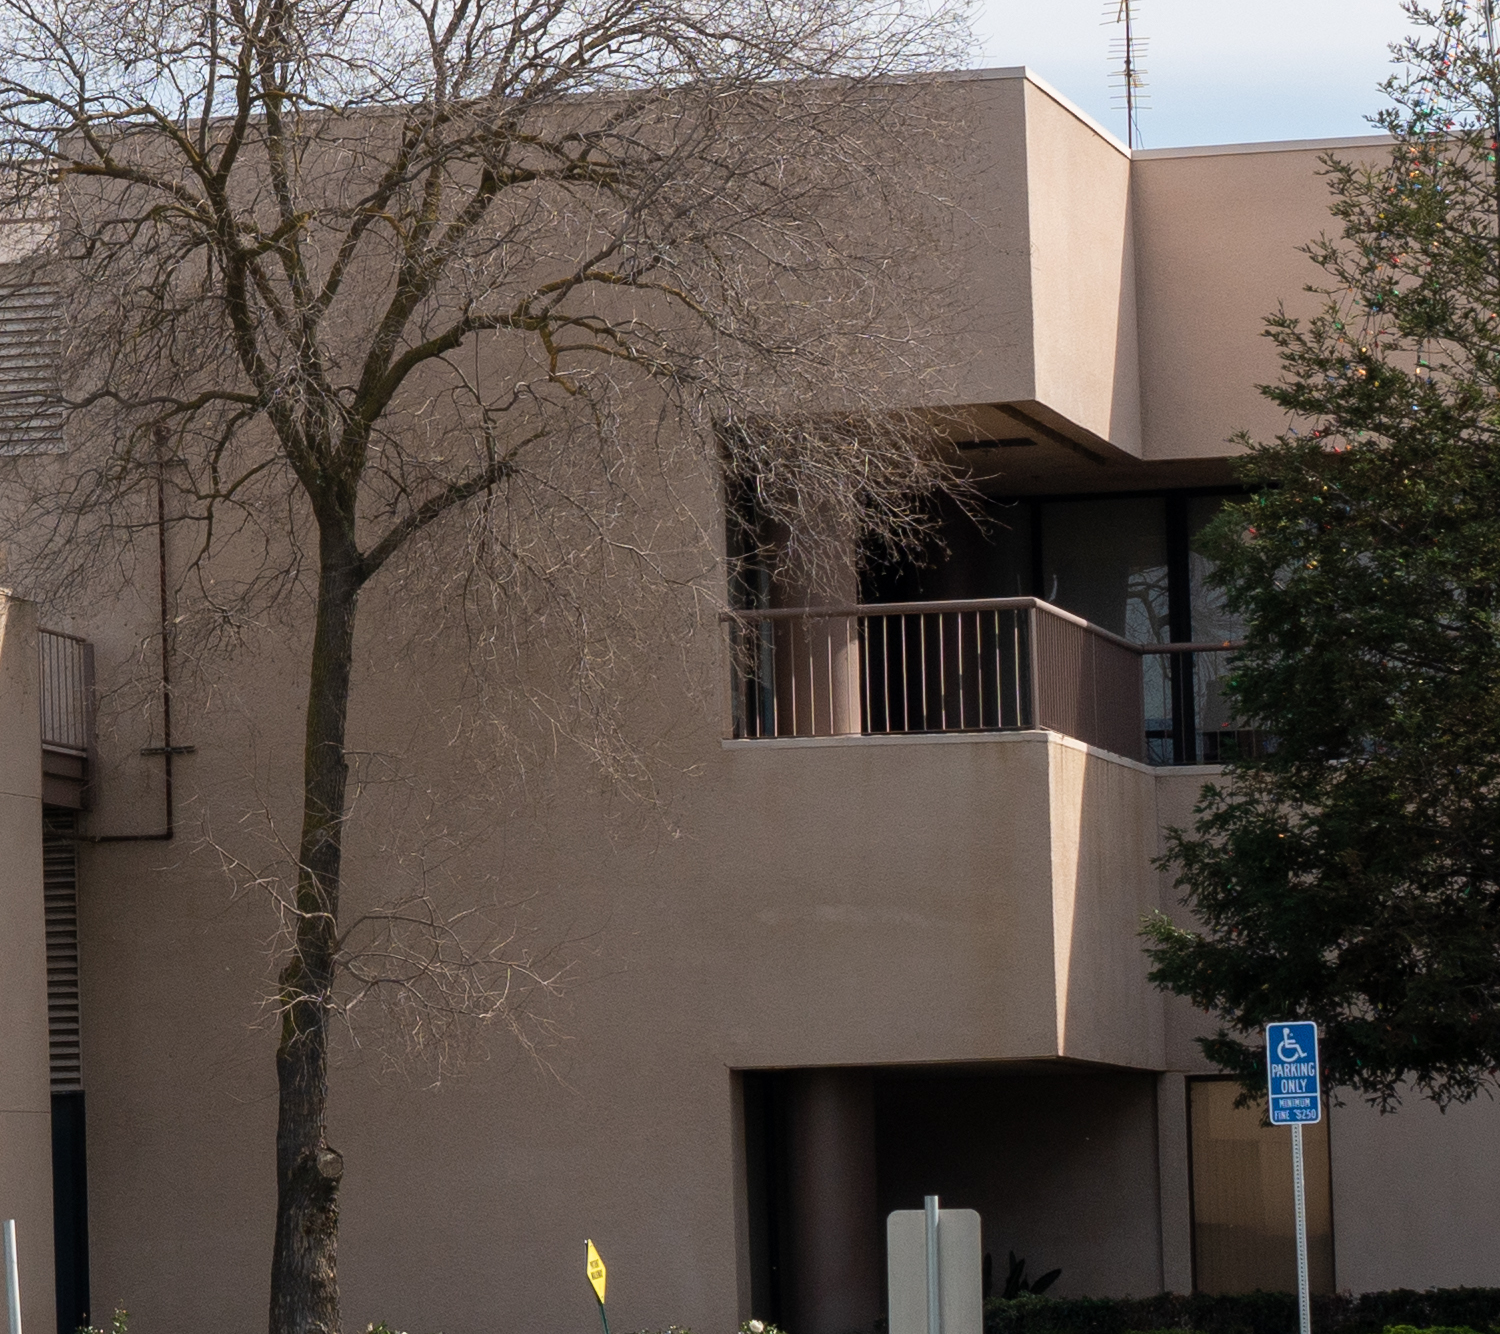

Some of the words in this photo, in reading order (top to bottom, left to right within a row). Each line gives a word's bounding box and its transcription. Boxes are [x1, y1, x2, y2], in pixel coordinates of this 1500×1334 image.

[1272, 1062, 1315, 1077] PARKING
[1281, 1079, 1307, 1093] ONLY
[1279, 1098, 1310, 1108] MINIMUM
[1274, 1110, 1290, 1120] FINE
